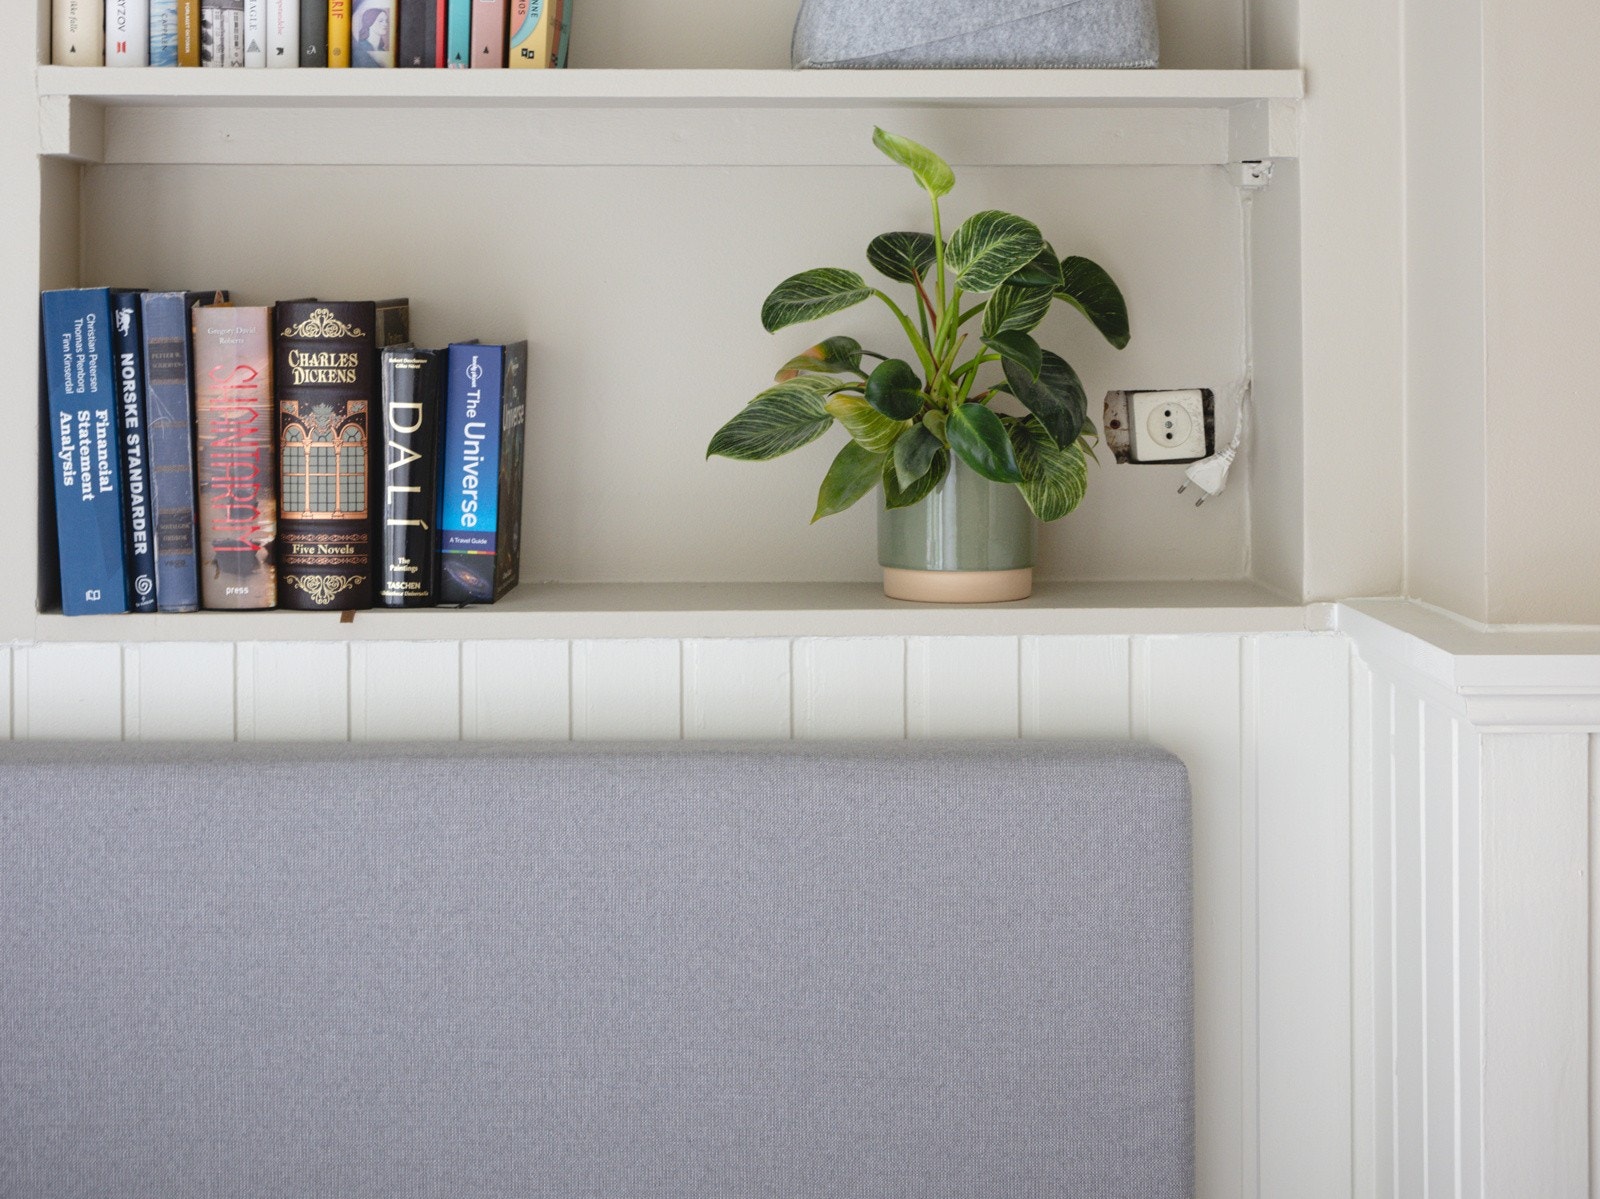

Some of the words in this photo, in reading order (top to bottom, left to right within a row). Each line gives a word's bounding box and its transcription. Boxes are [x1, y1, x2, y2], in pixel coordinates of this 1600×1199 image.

[68, 16, 77, 33] falle
[62, 333, 72, 352] Finn
[74, 319, 85, 353] Thomas
[86, 313, 97, 353] Christian
[63, 353, 74, 394] Kinserdal
[74, 354, 86, 394] Plenborg
[88, 354, 99, 393] Petersen
[288, 350, 359, 367] CHARLES
[292, 366, 356, 385] DICKENS
[120, 353, 140, 428] NORSKE
[466, 389, 480, 418] The
[57, 411, 76, 487] Analysis
[77, 410, 94, 501] Statement
[95, 409, 112, 493] Financial
[208, 364, 262, 553] SHANTARAM
[387, 402, 429, 530] DALÍ
[126, 433, 147, 555] STANDARDER
[461, 422, 486, 527] Universe
[293, 544, 316, 555] Five
[317, 544, 355, 555] Novels
[225, 586, 249, 595] press
[387, 581, 421, 589] TASCHEN
